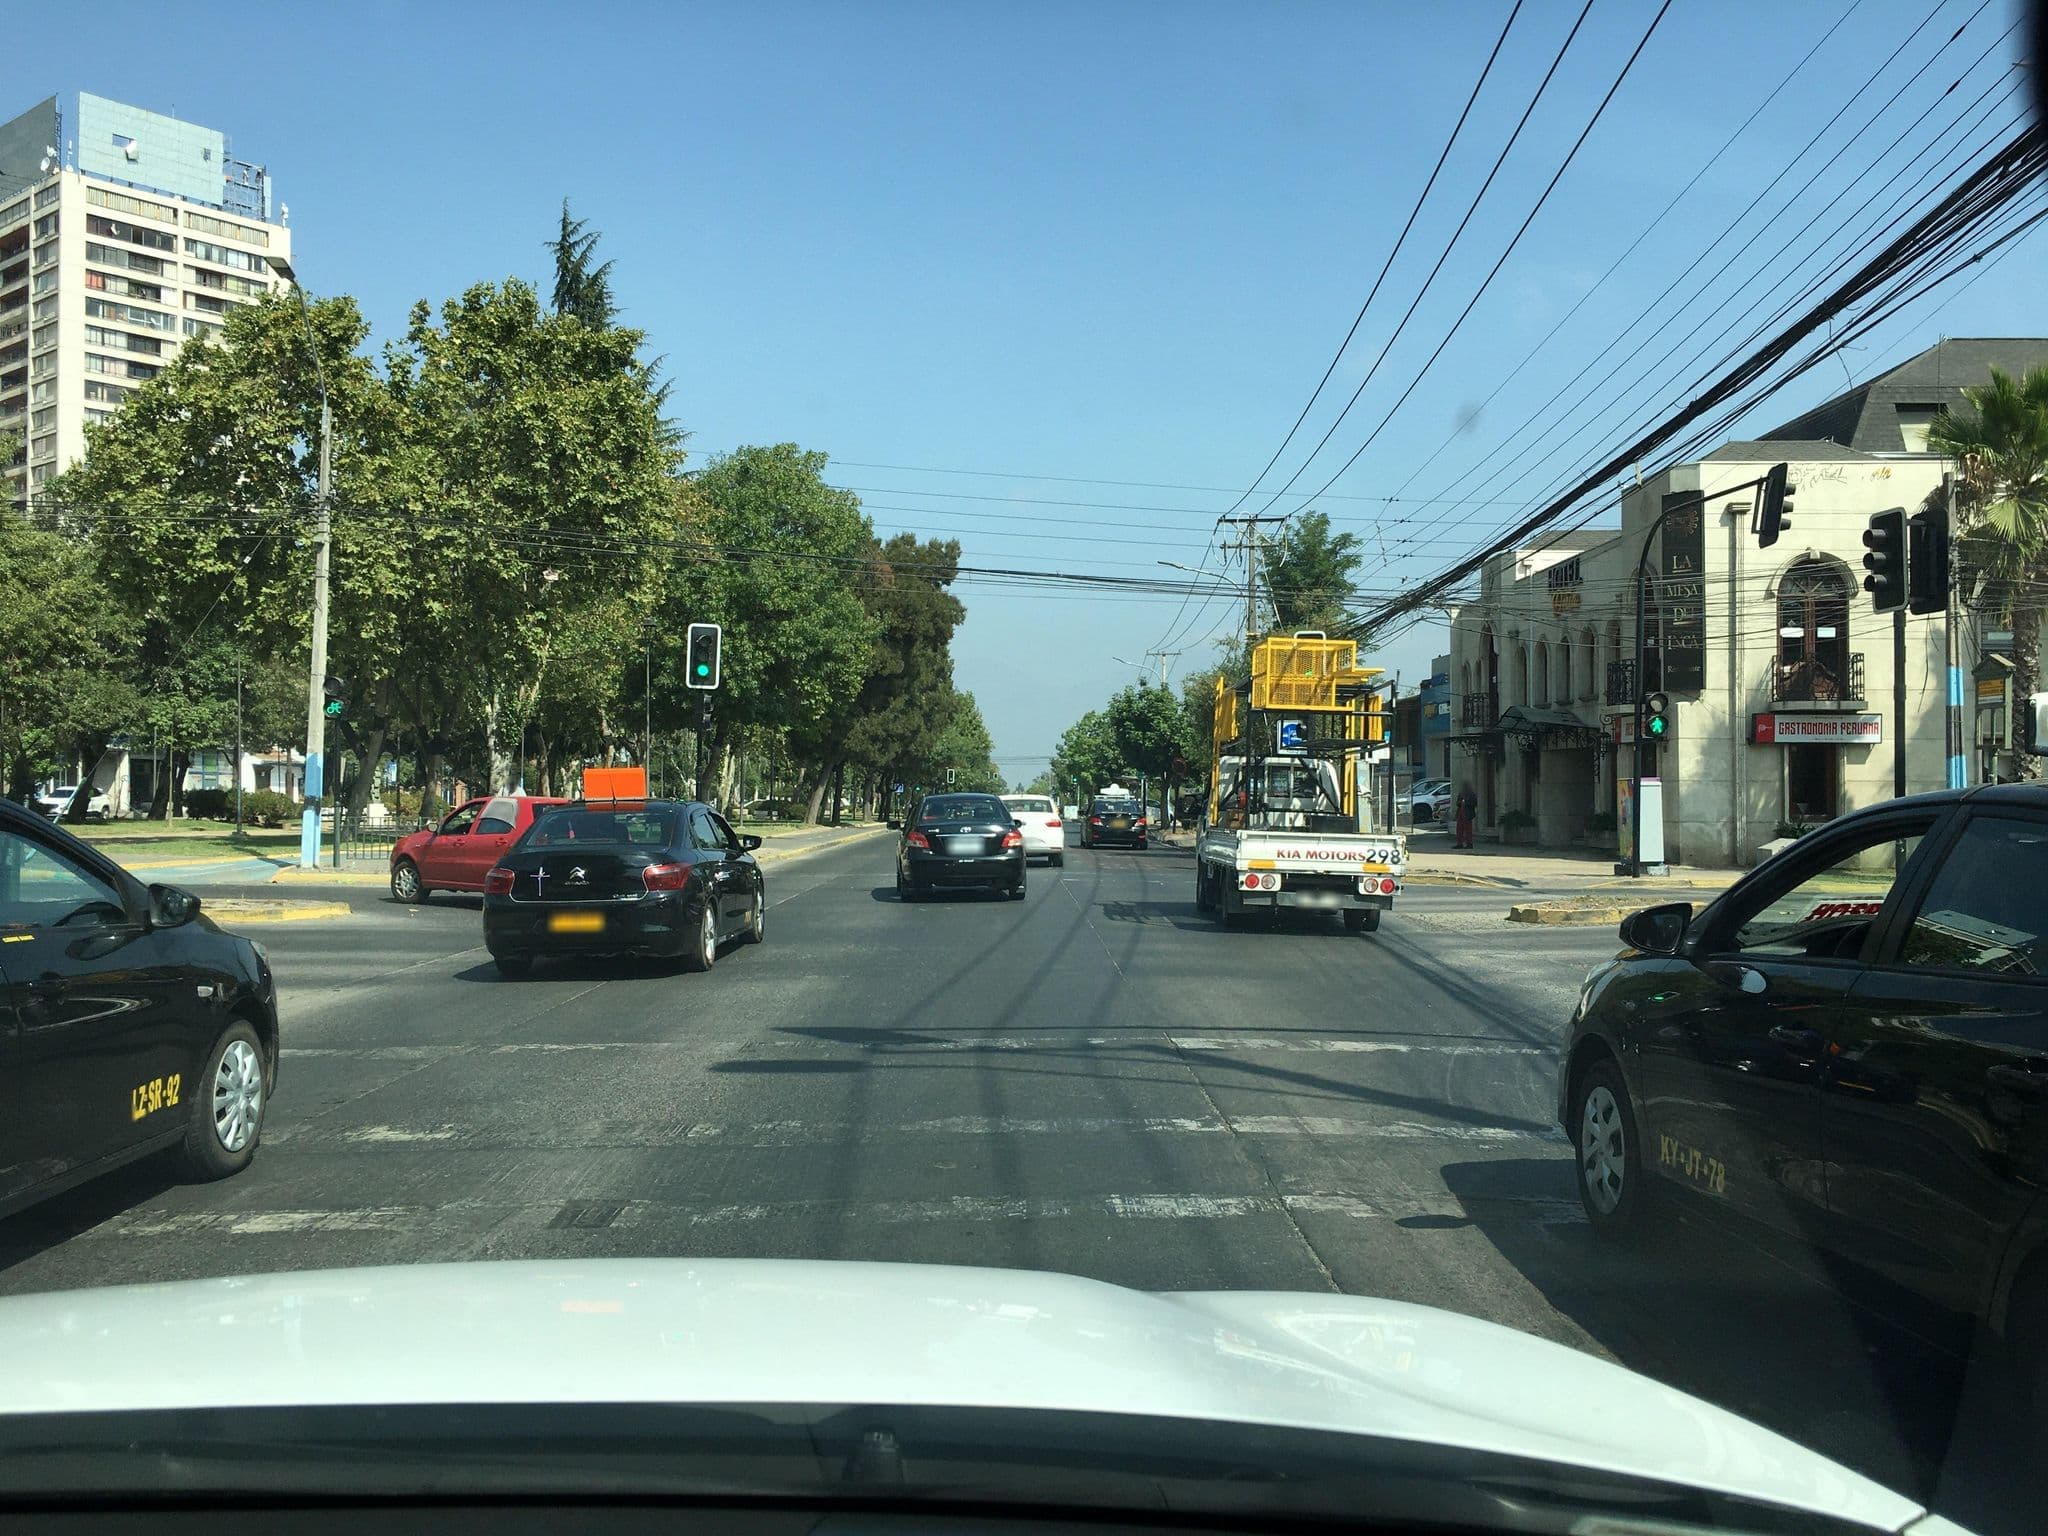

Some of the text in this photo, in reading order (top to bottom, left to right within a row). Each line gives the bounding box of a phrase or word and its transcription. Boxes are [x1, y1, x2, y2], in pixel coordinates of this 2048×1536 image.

[1672, 555, 1693, 570] LA
[1667, 583, 1698, 597] MESA
[1778, 721, 1880, 735] GASTRONOMIA PERUANA
[1276, 848, 1400, 865] KIA MOTORS 298
